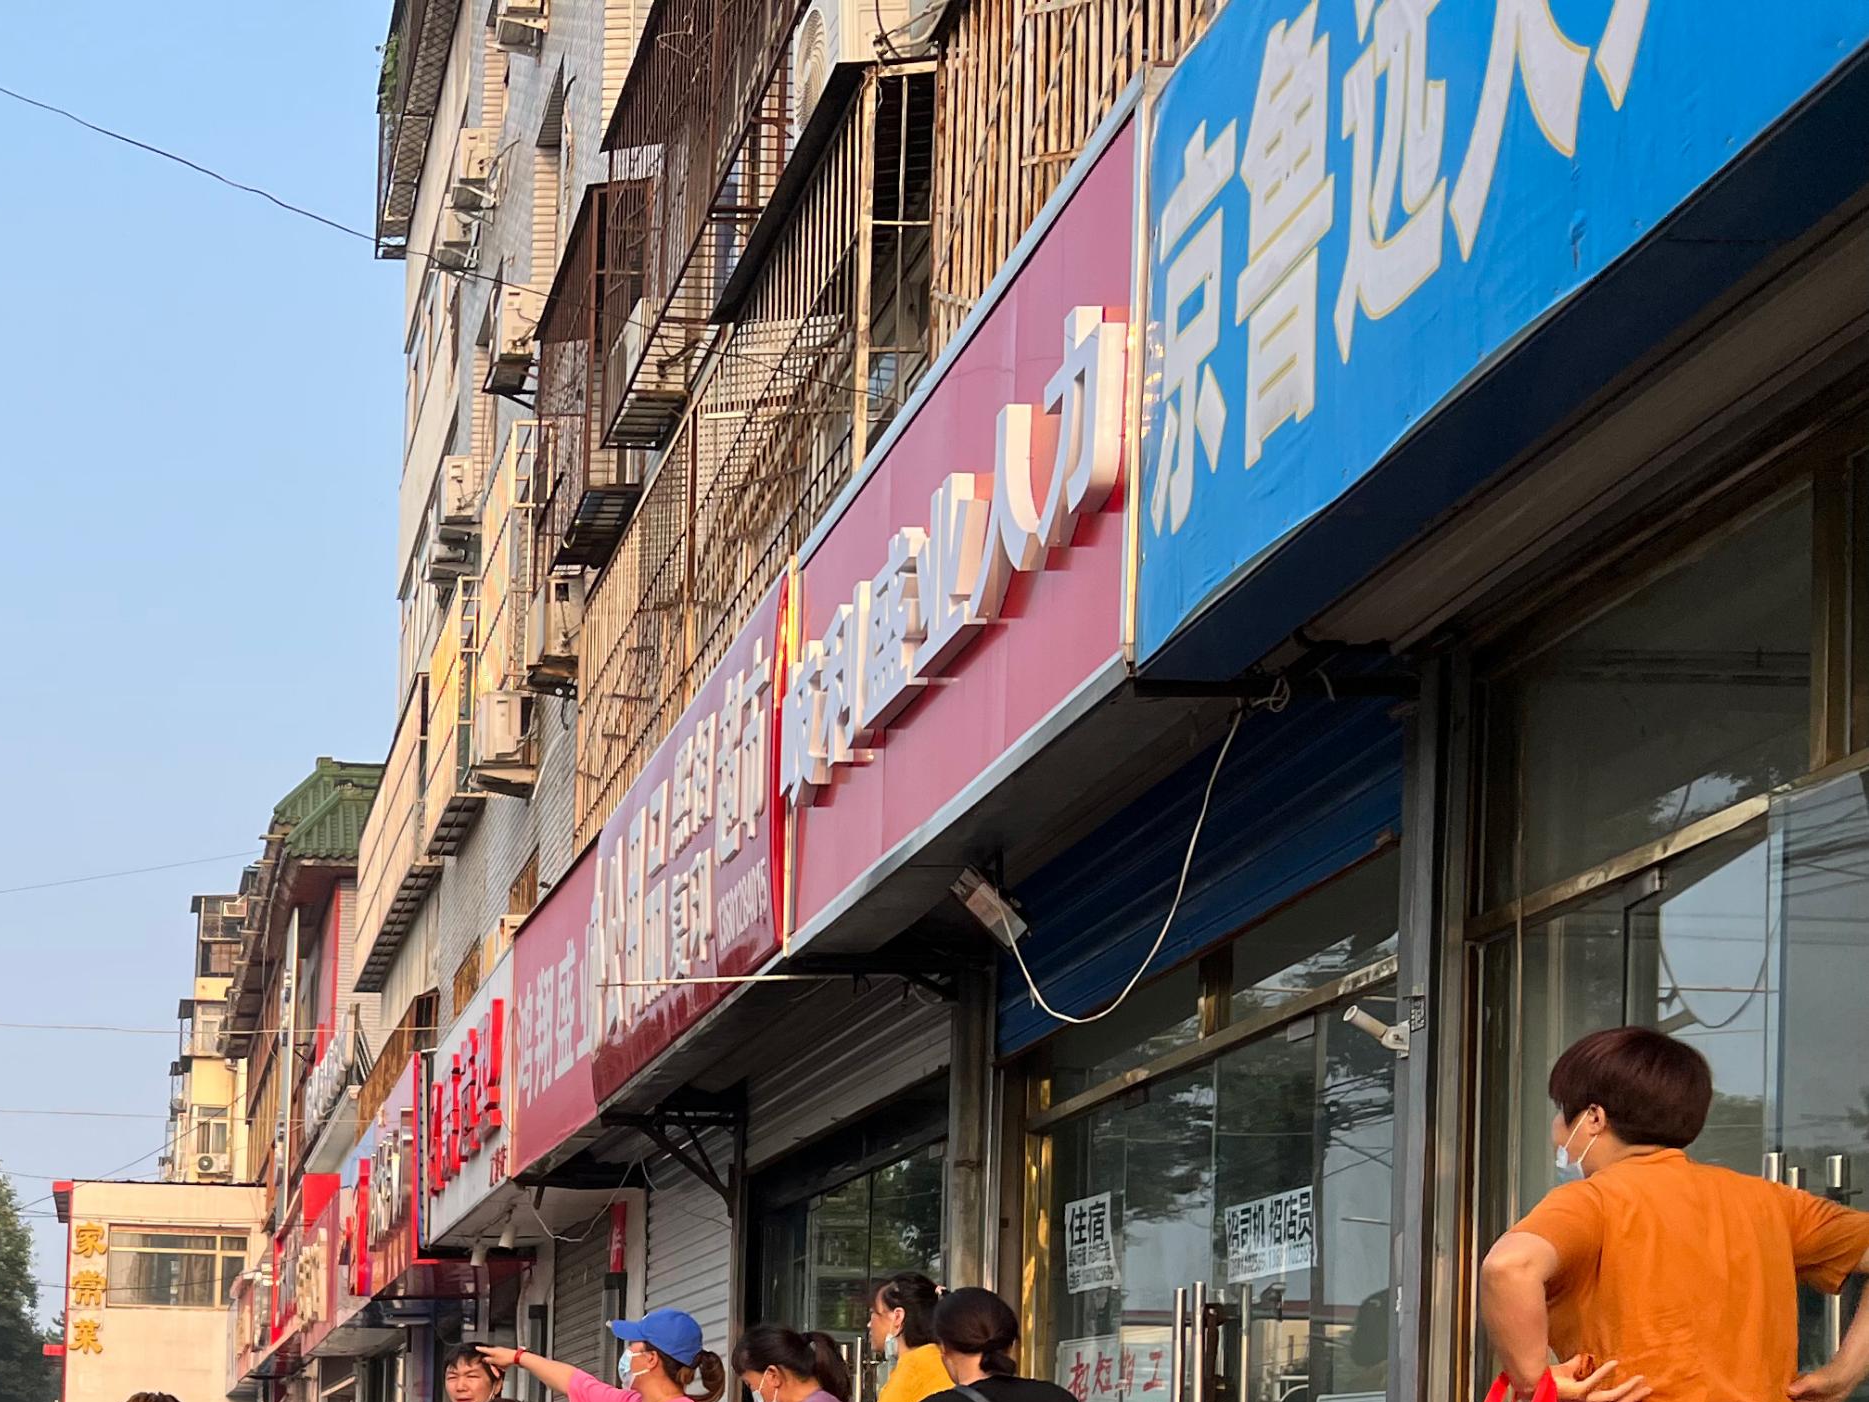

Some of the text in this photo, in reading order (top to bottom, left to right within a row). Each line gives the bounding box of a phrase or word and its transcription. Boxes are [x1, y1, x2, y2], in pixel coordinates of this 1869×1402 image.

[715, 637, 771, 867] 超市
[1070, 1200, 1106, 1249] 住宿
[1227, 1191, 1312, 1250] 招司机 招店员
[69, 1220, 108, 1355] 家常菜
